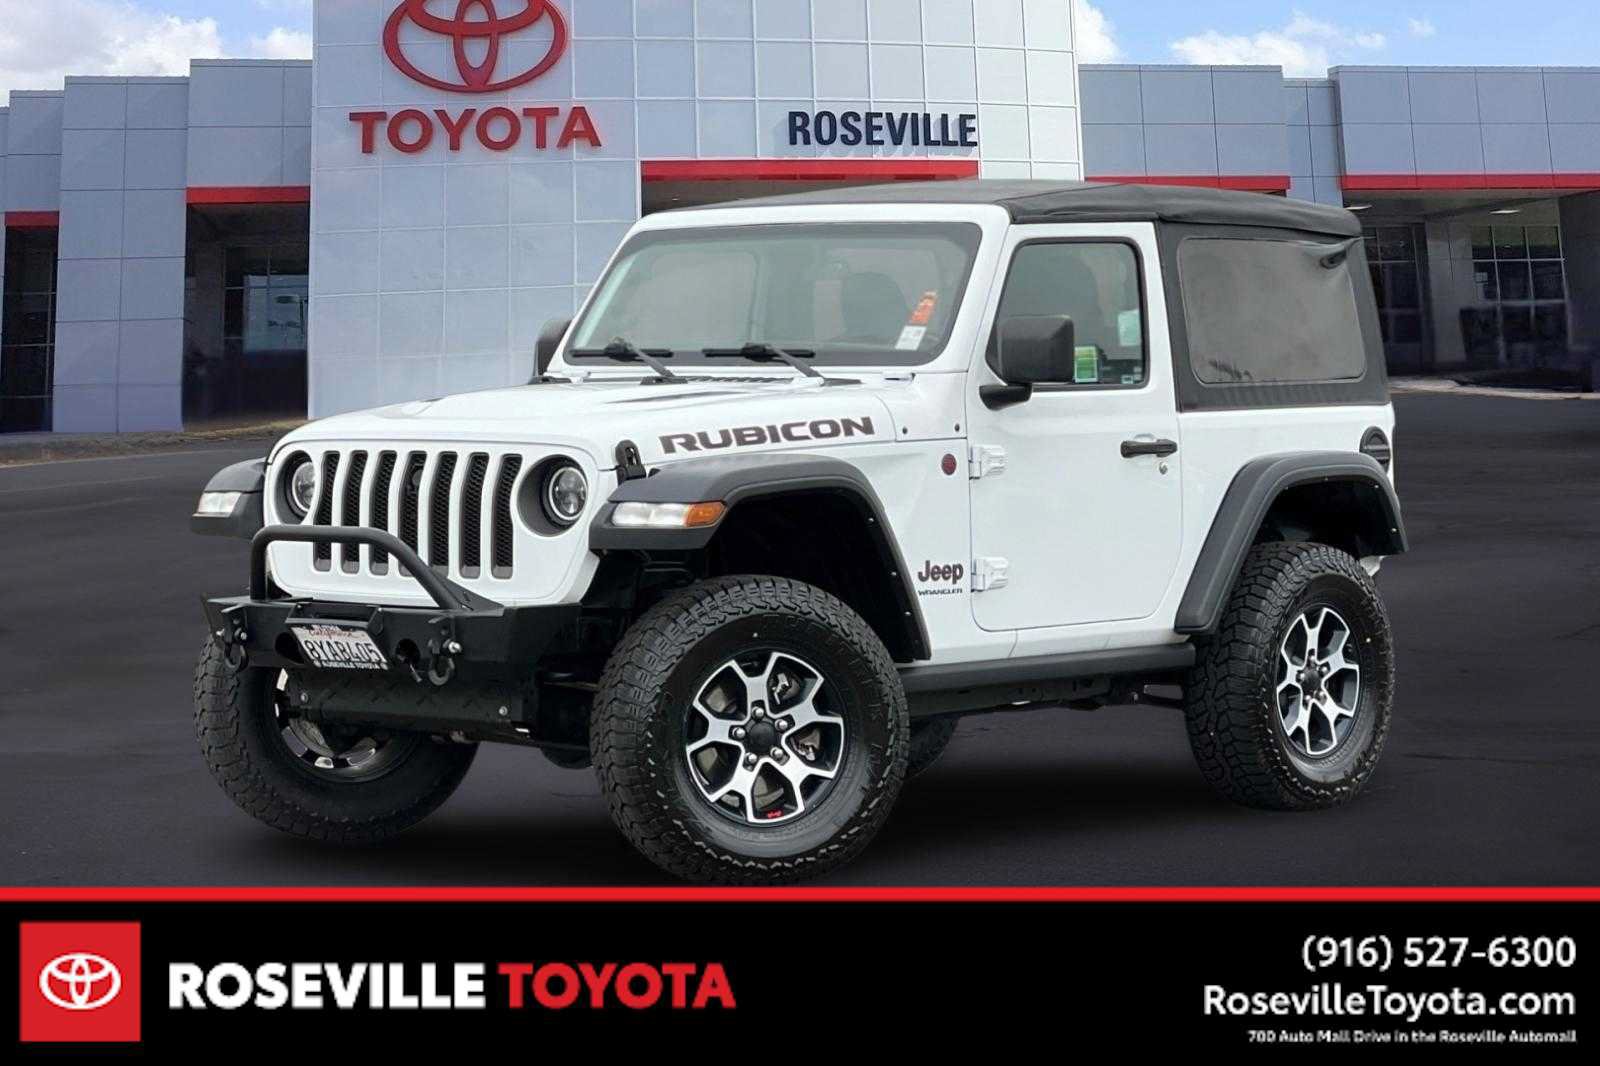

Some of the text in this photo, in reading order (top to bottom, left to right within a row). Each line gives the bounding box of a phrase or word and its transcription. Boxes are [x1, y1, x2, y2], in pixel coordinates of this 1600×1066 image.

[349, 106, 602, 154] TOYOTA
[788, 111, 978, 147] ROSEVILLE
[658, 416, 875, 454] RUBICON
[917, 560, 964, 584] Jeep
[918, 588, 963, 596] WRANGLER
